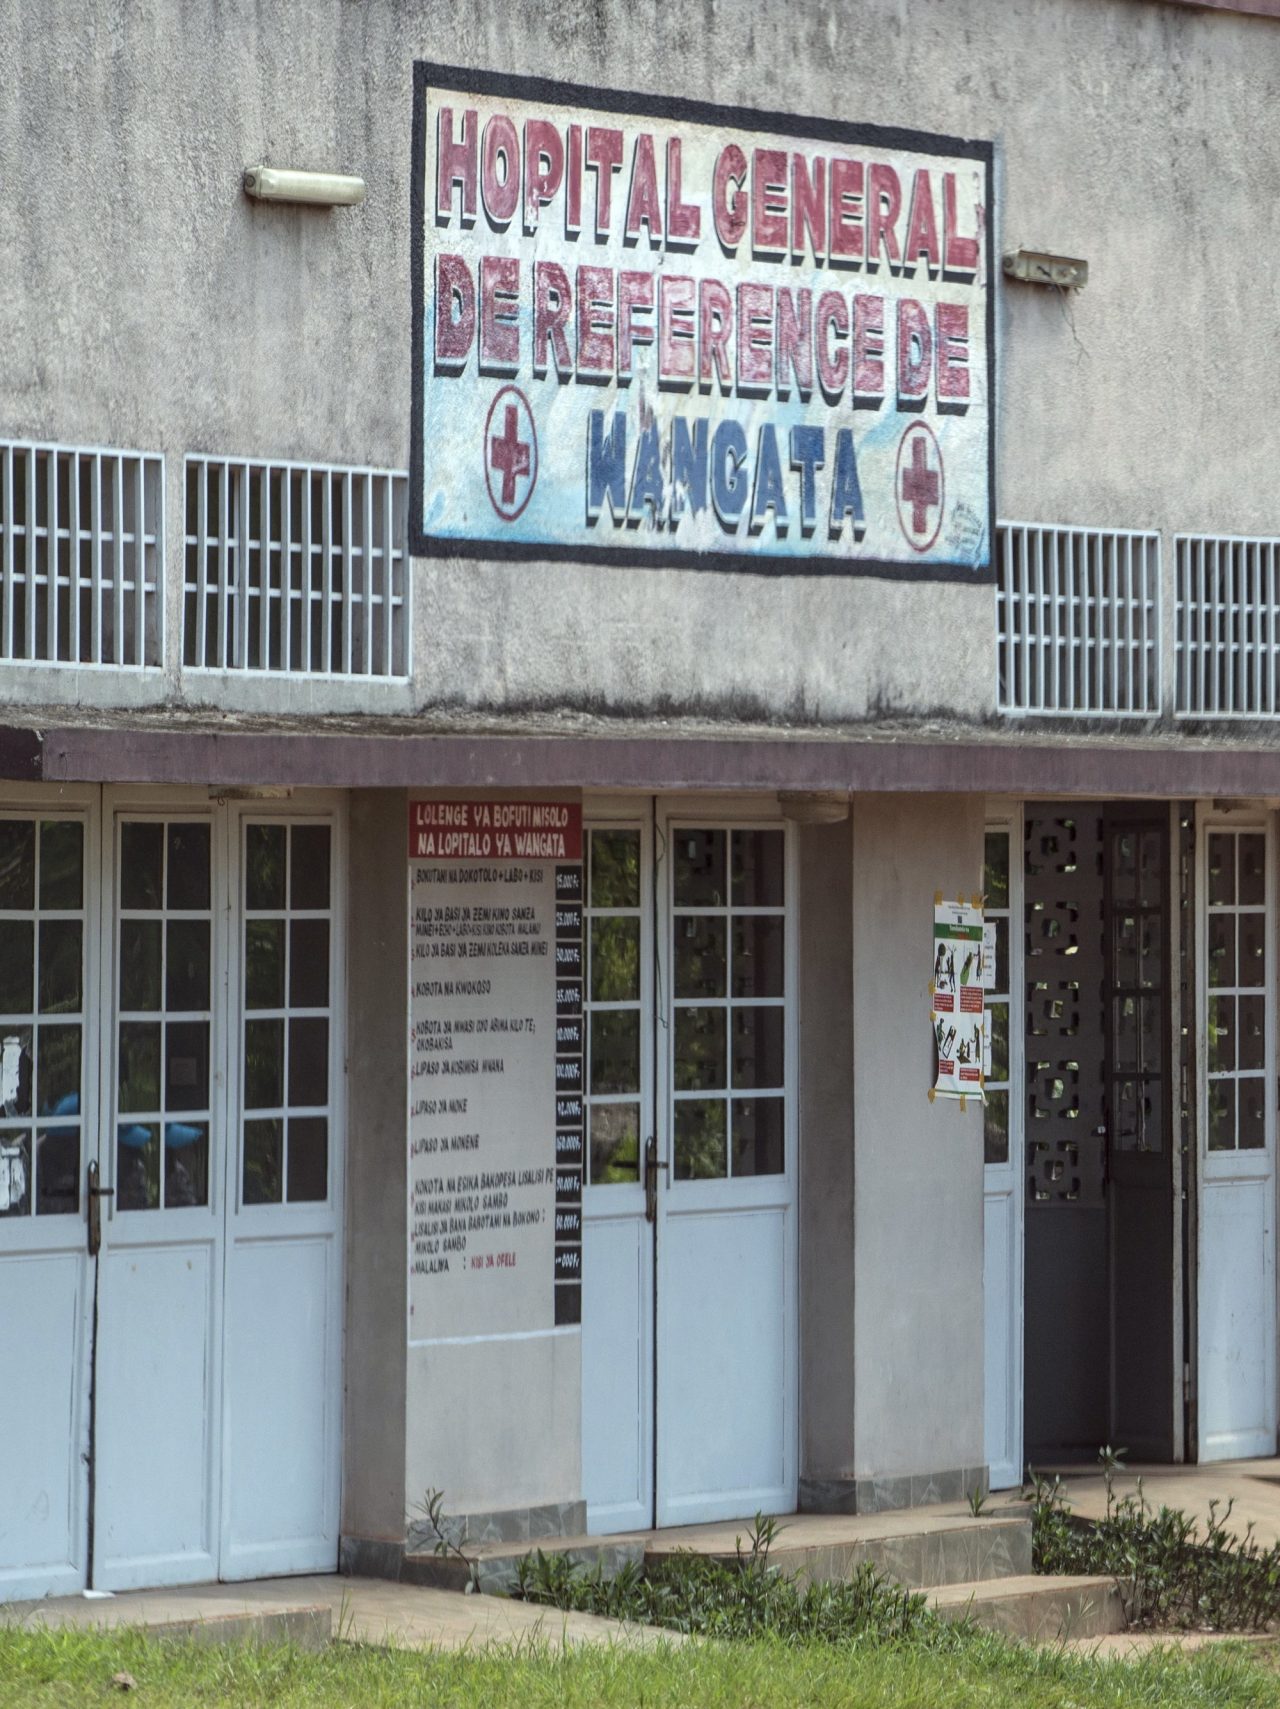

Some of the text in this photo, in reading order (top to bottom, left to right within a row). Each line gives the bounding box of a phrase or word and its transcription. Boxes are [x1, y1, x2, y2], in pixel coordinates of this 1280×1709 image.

[435, 106, 979, 284] HOPITAL GENERAL
[433, 253, 971, 415] DE REFERENCE DE
[586, 409, 867, 542] WANGATA
[416, 804, 569, 828] LOLENGE YA BOFUTI MISOLO
[417, 832, 566, 857] NA LOPITALO YA WANGATA
[459, 867, 497, 883] DOKOTOLO
[504, 867, 523, 883] LABO
[416, 907, 433, 922] KILO
[416, 981, 443, 997] KOBOTA
[444, 981, 454, 997] NA
[482, 1192, 508, 1210] SAMBO
